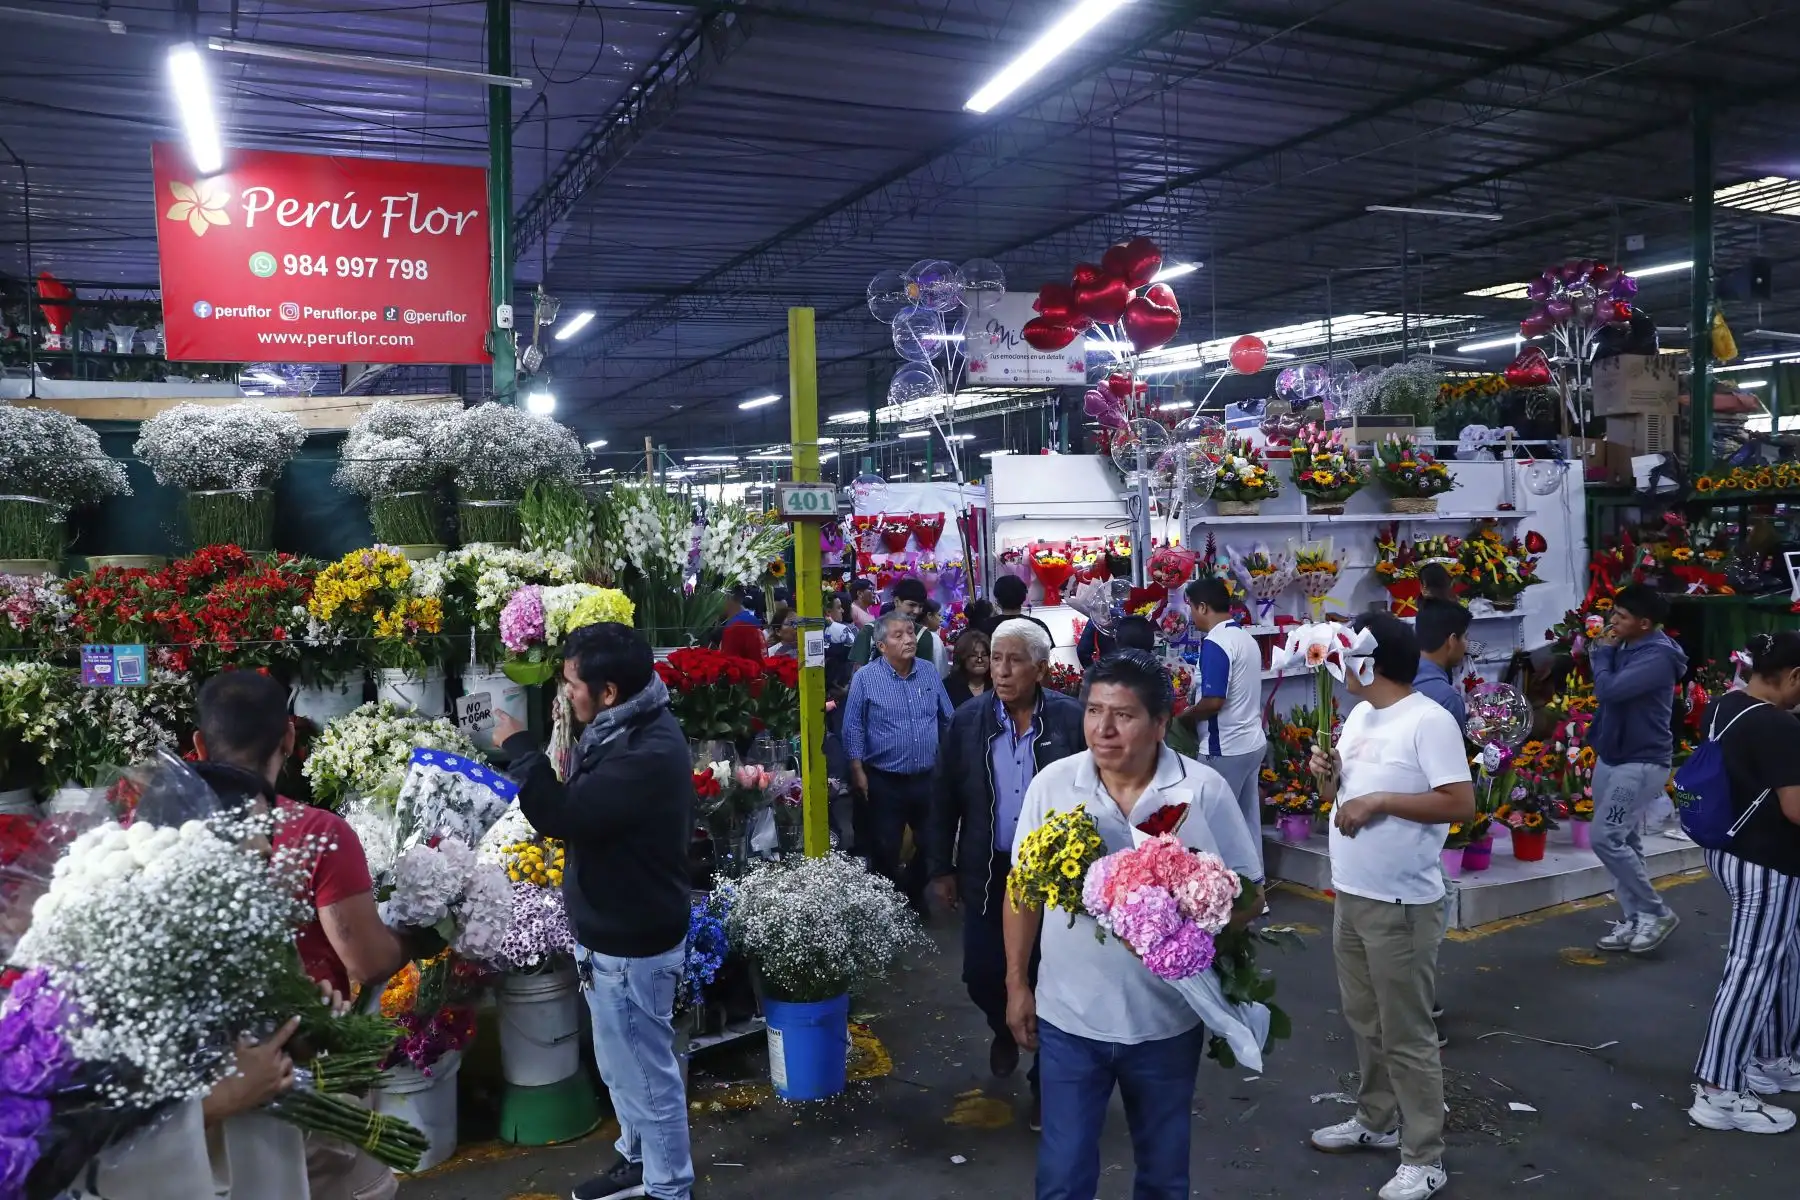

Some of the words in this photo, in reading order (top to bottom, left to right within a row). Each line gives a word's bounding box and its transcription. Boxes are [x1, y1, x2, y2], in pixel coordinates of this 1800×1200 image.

[241, 186, 372, 229] Perú
[380, 191, 478, 238] Flor
[283, 253, 329, 277] 984
[336, 256, 379, 278] 997
[386, 258, 429, 281] 798
[215, 304, 272, 320] peruflor
[303, 306, 377, 322] Peruflor.pe
[403, 309, 467, 324] @peruflor
[257, 330, 414, 348] www.peruflor.com
[788, 491, 831, 511] 401
[466, 701, 481, 715] NO
